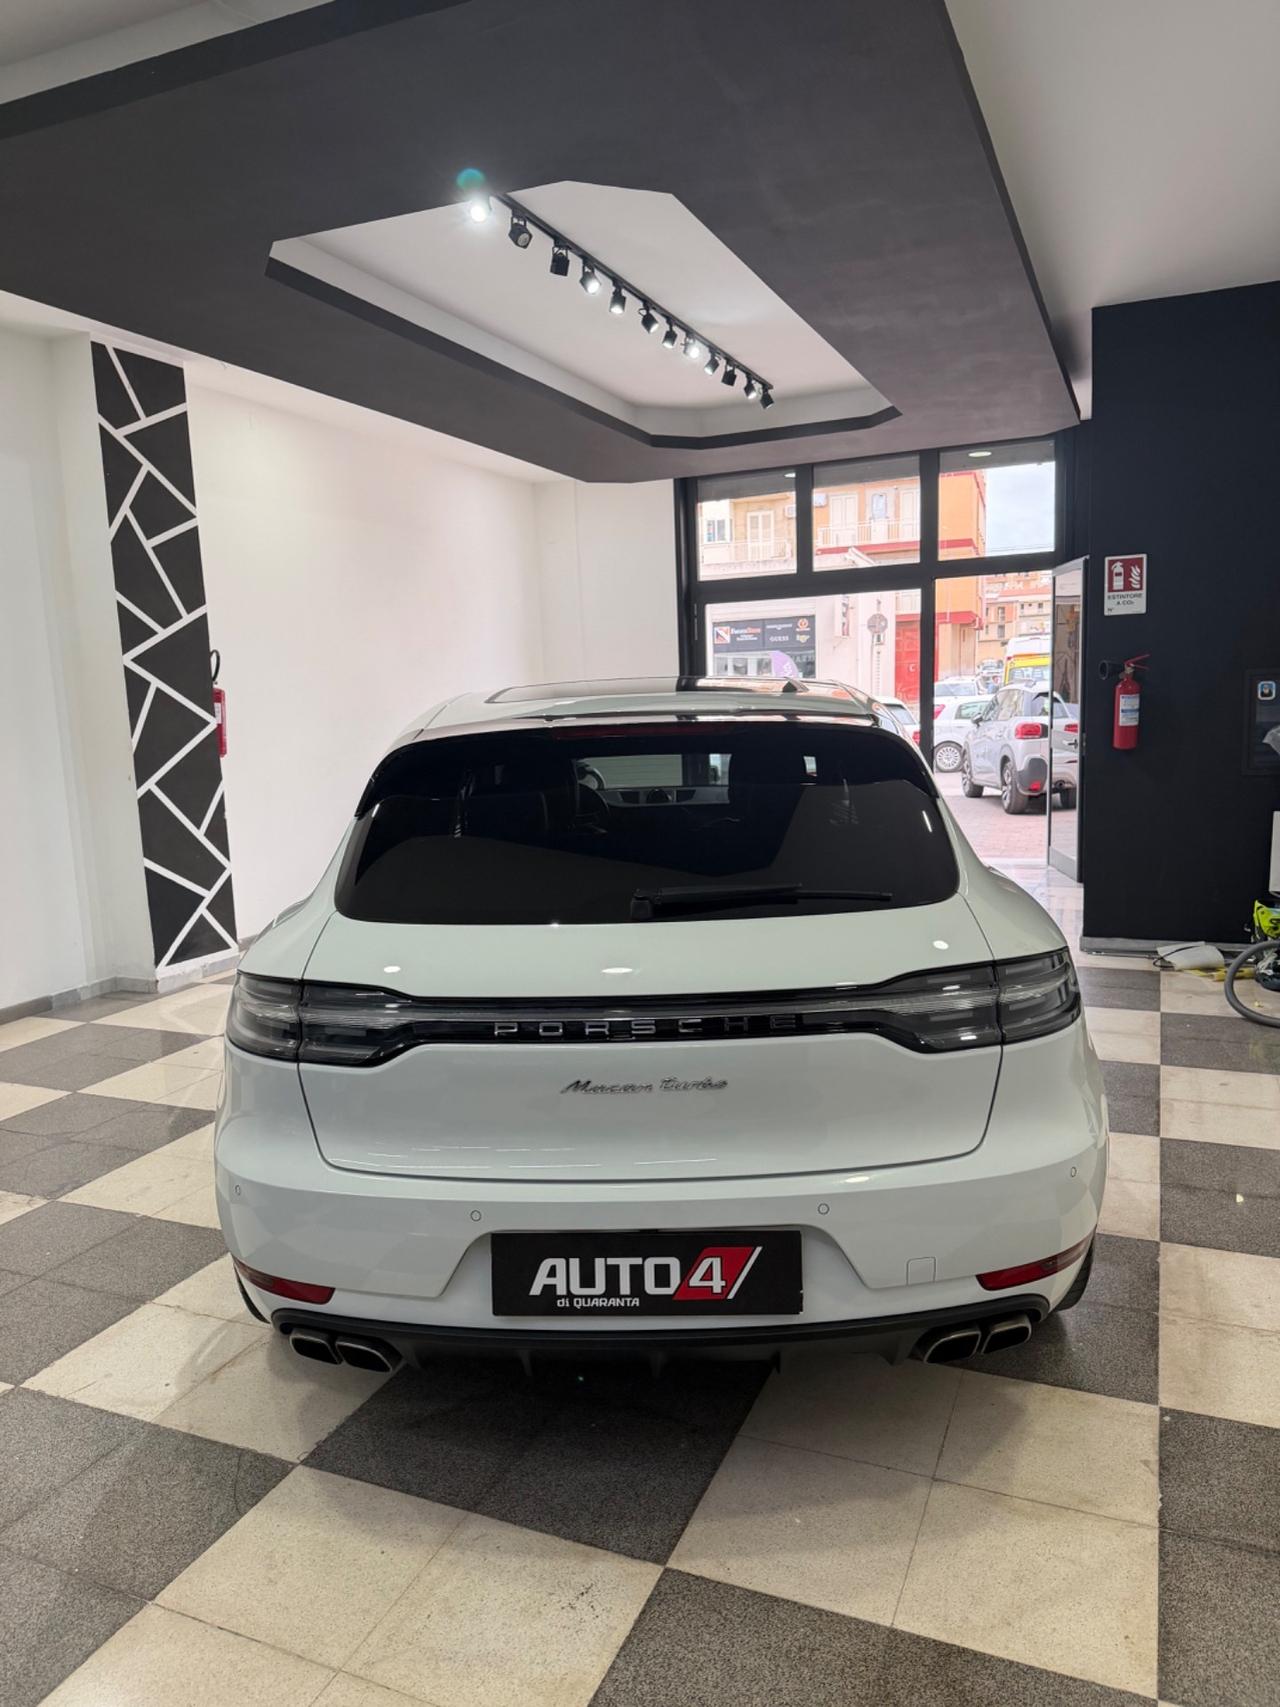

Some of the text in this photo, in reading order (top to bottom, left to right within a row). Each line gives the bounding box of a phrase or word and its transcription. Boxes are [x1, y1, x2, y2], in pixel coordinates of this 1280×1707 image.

[493, 1018, 797, 1037] PORSCHE
[561, 1079, 654, 1094] Macan
[557, 1297, 640, 1309] di QUARANTA
